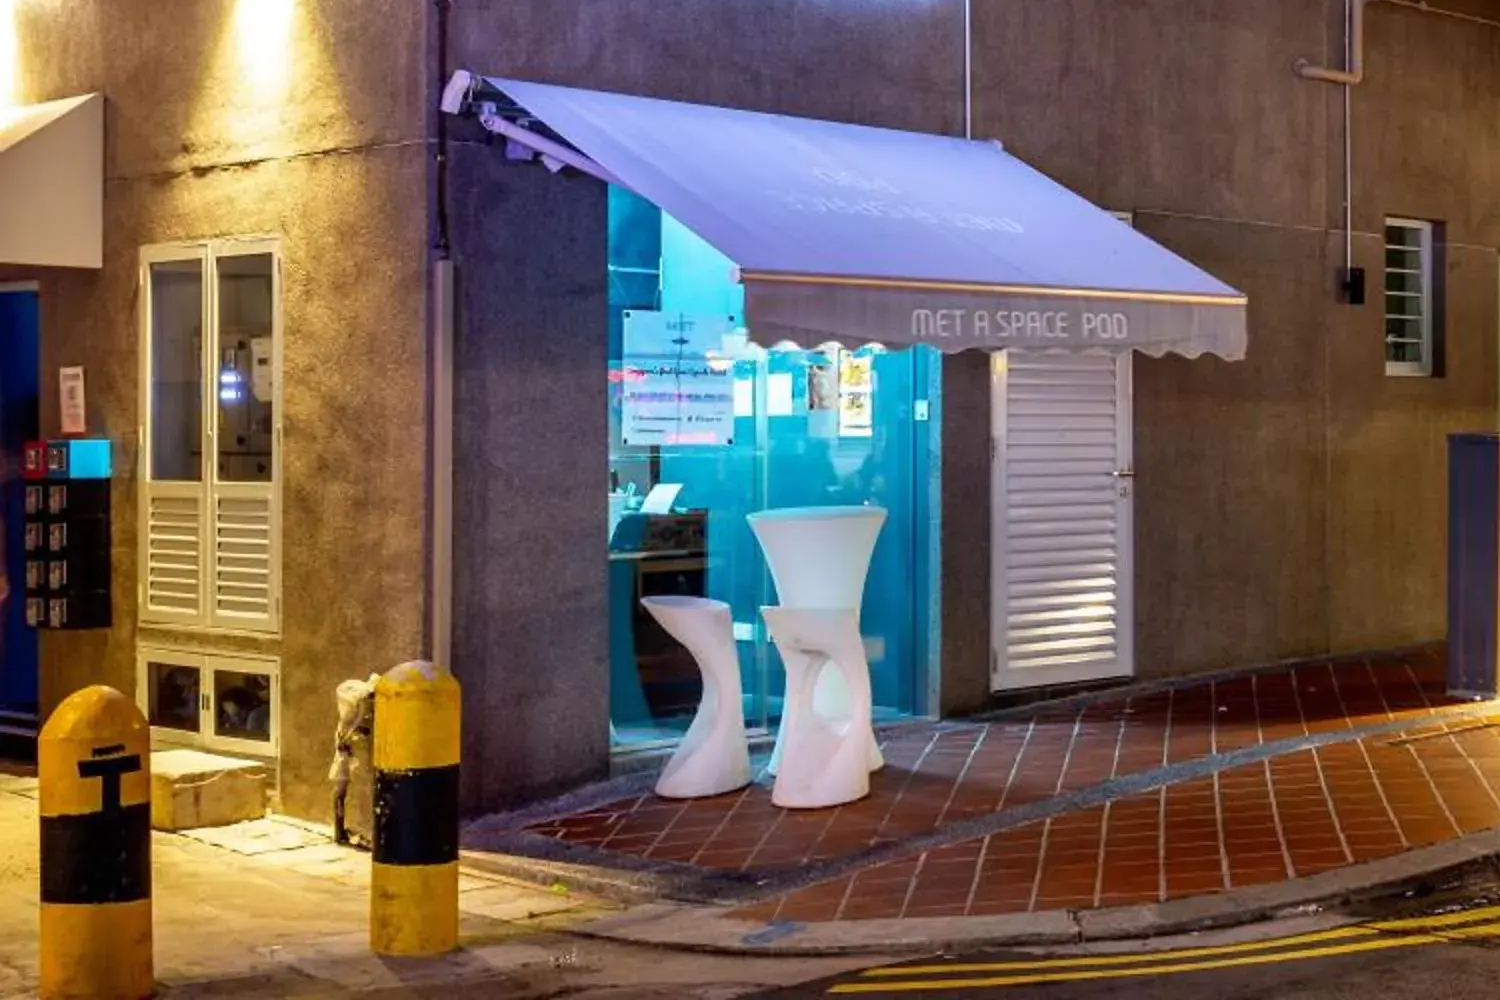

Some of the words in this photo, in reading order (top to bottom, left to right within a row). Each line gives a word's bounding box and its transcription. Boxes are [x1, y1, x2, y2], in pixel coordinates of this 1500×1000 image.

[911, 308, 966, 338] MET
[974, 310, 989, 337] A
[995, 311, 1069, 338] SPACE
[1082, 312, 1128, 339] POD
